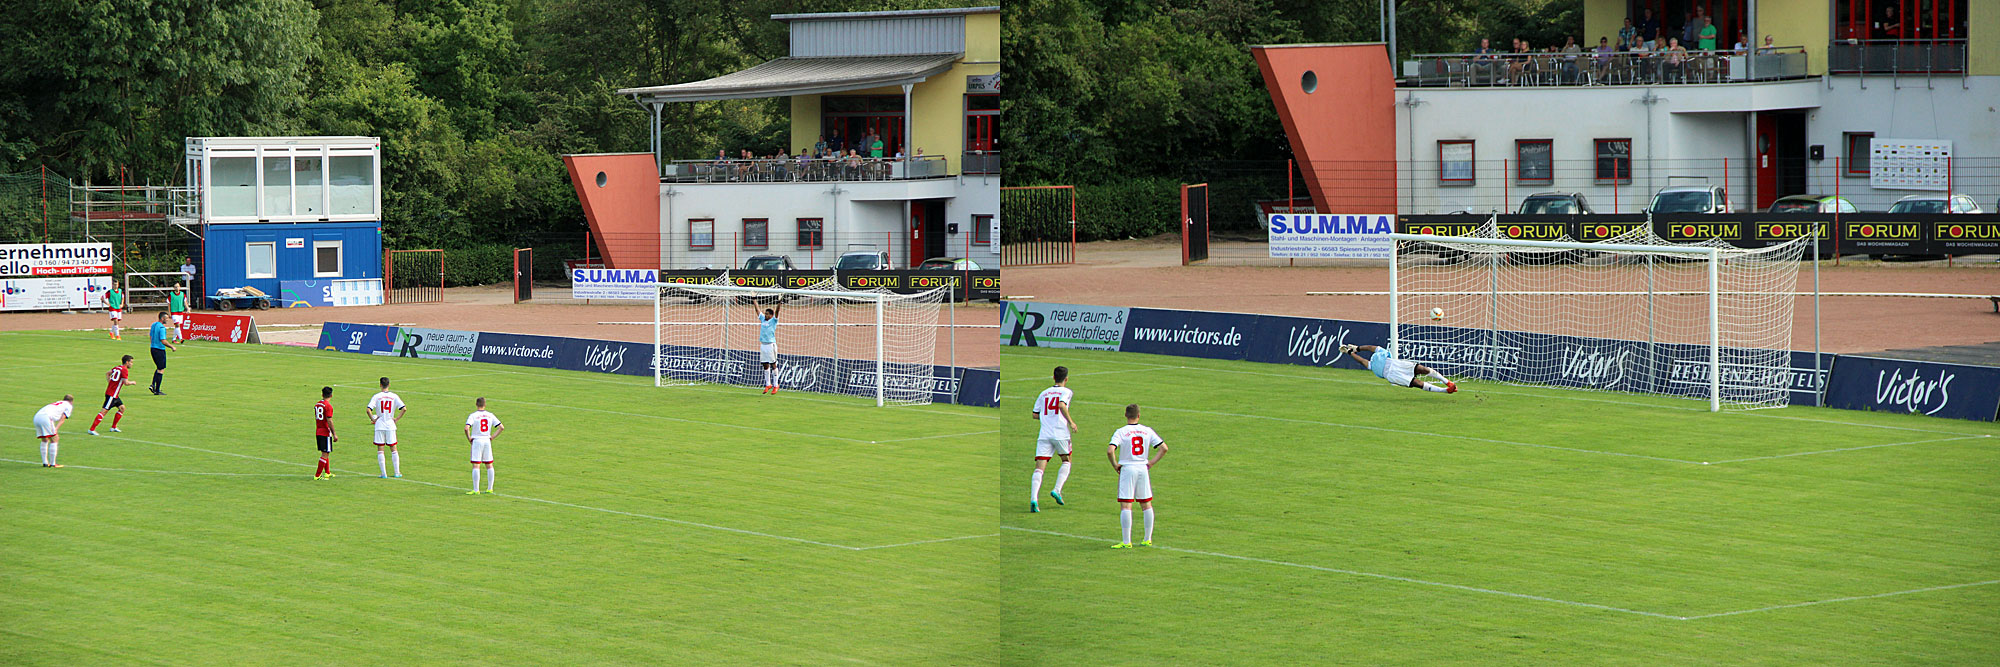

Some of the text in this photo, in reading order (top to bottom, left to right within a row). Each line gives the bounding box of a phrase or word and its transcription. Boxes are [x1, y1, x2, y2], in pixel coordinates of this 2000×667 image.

[1270, 214, 1392, 234] S.U.M.M.A
[1497, 225, 1563, 238] FORUM
[1670, 224, 1738, 238] FORUM
[1848, 224, 1917, 238] FORUM
[0, 244, 111, 261] ernehmung
[0, 261, 30, 274] ello
[574, 270, 657, 283] S.U.M.M.A
[729, 278, 775, 286] FORUM
[850, 278, 898, 286] FORUM
[1050, 310, 1123, 324] neue raum- &
[426, 332, 475, 344] neue raum- &
[1046, 325, 1120, 344] umweltpflege
[1134, 324, 1242, 346] www.victors.de
[424, 342, 473, 357] umweltpflege
[481, 344, 554, 359] www.victors.de
[1288, 325, 1350, 366] Victor's
[584, 345, 628, 372] Victor's
[1562, 345, 1630, 389] Victor's
[850, 374, 959, 392] RESIENZ-HOTELS
[1672, 365, 1826, 388] RESIENZ-HOTELS
[1876, 368, 1955, 415] Victor's
[380, 400, 392, 414] 14
[1044, 396, 1060, 416] 14
[480, 418, 488, 432] 8
[1131, 436, 1144, 456] 8
